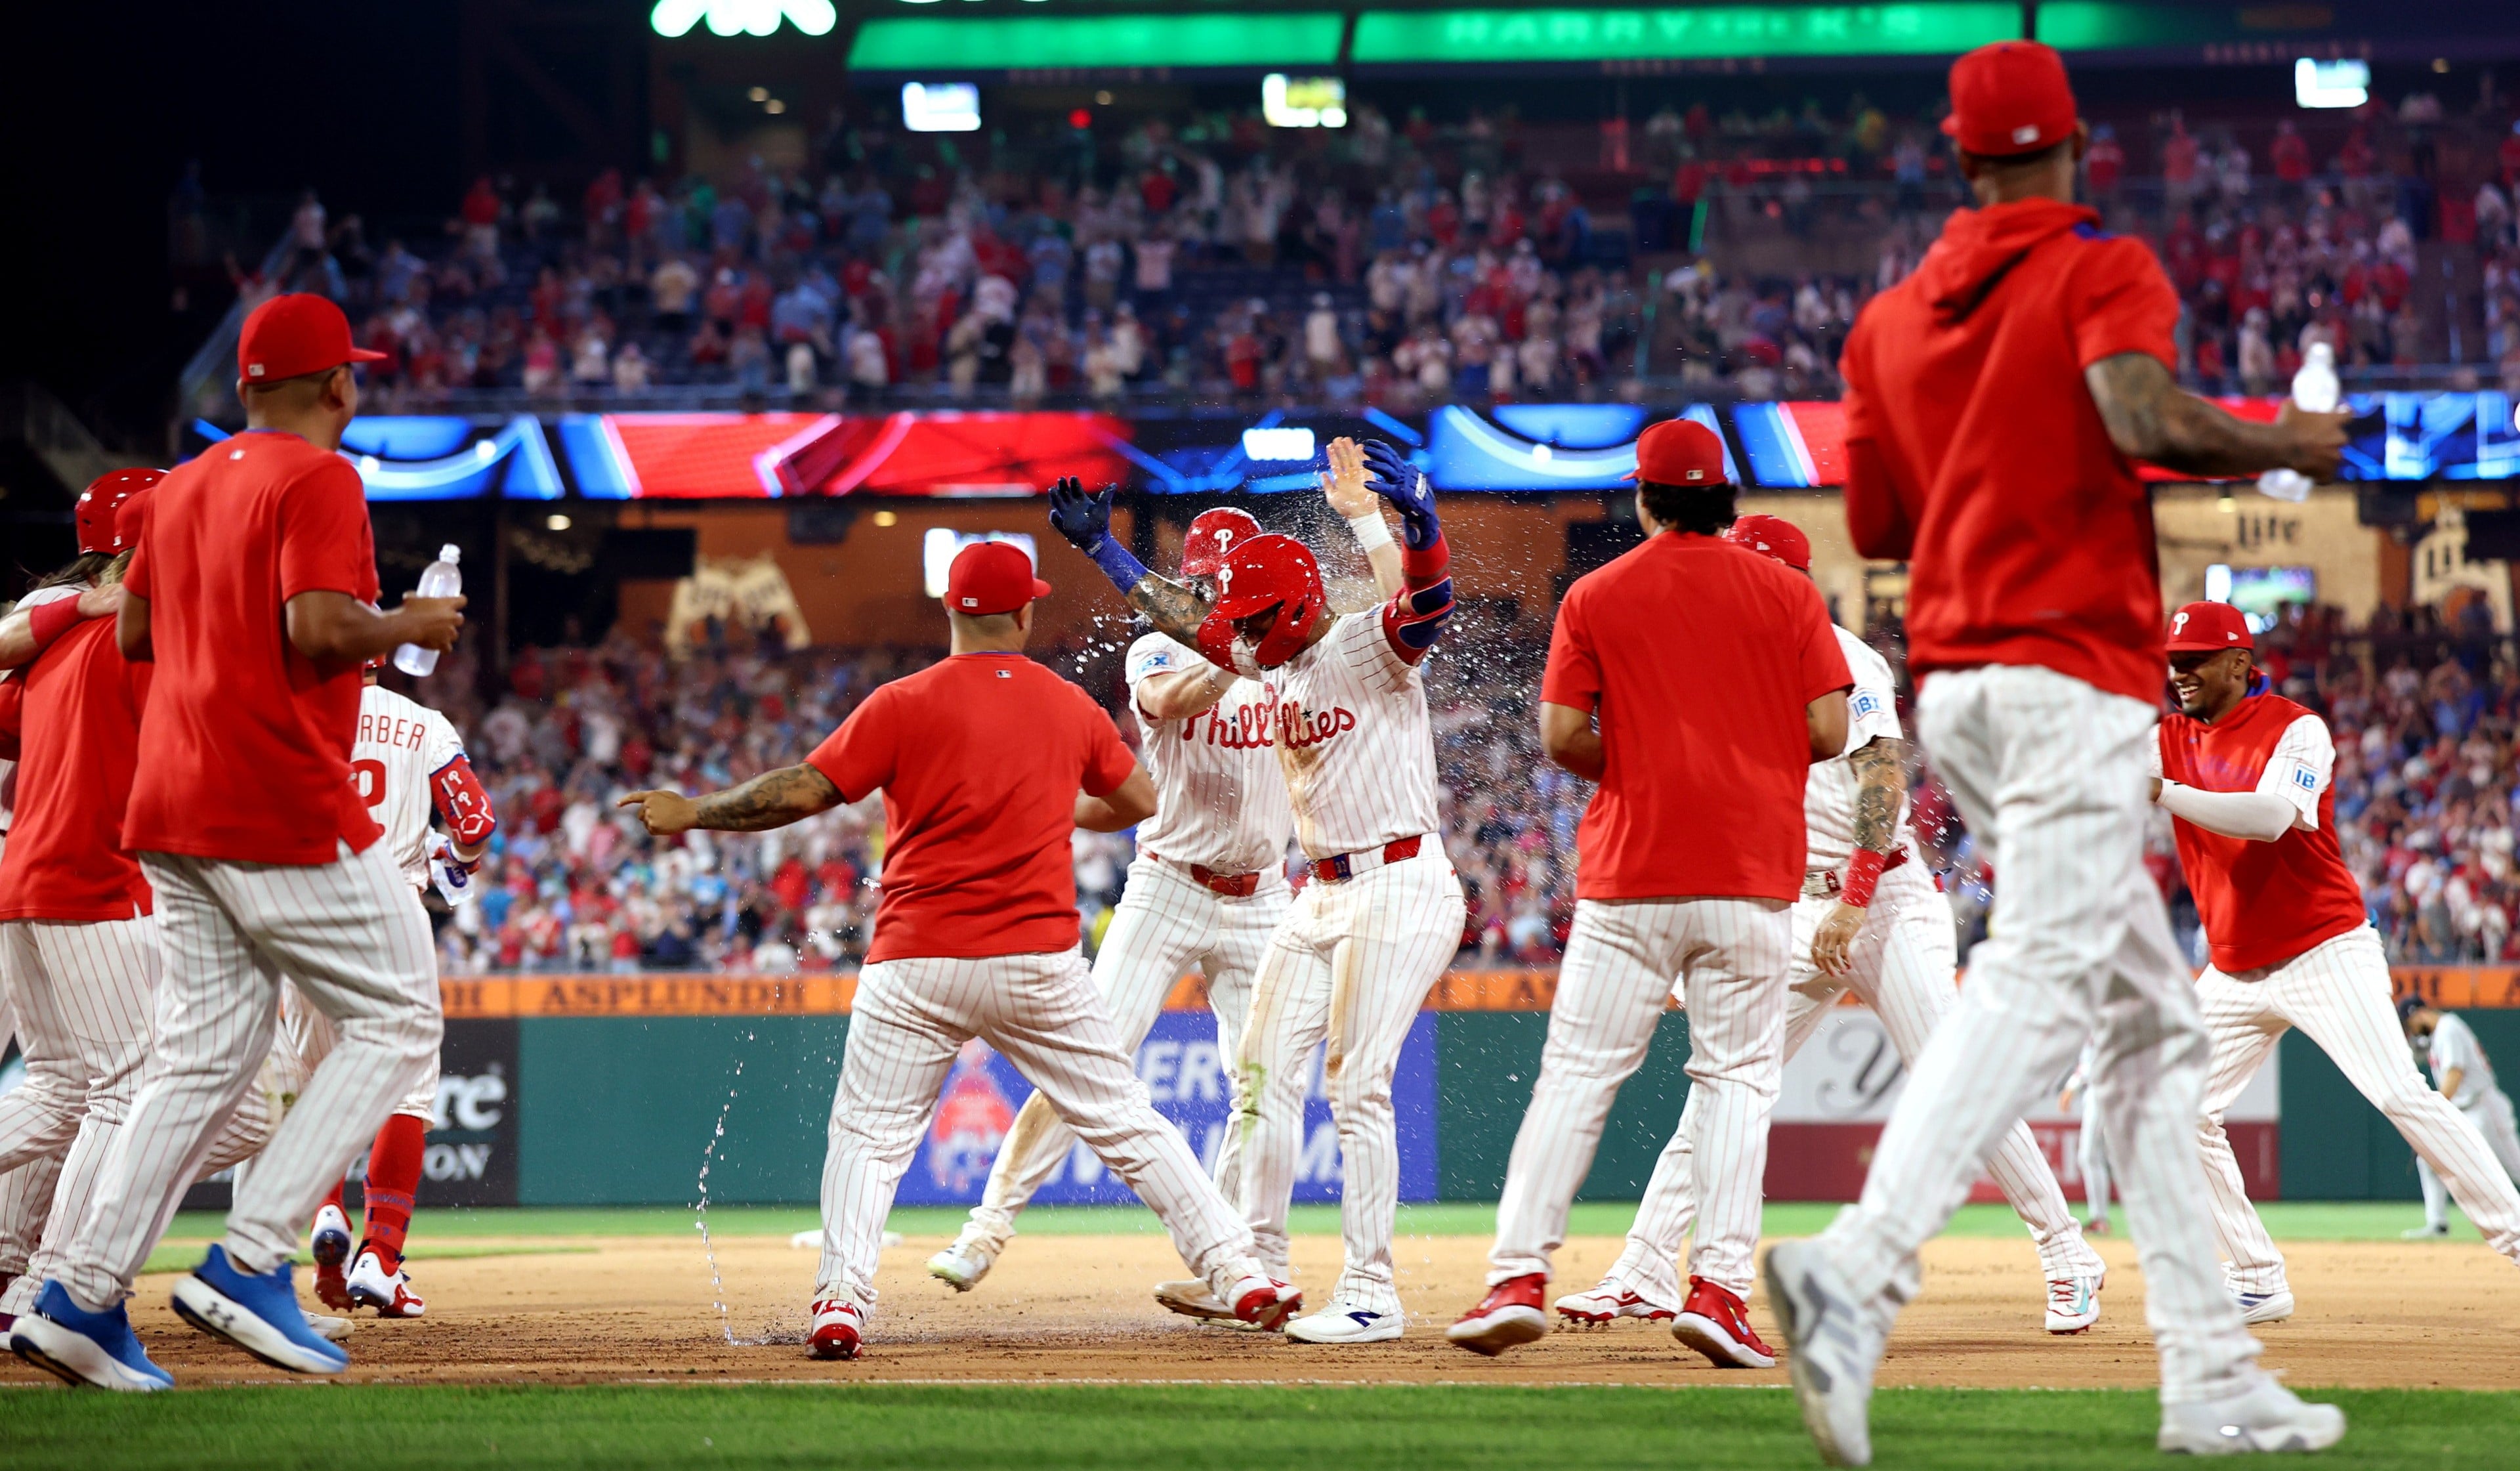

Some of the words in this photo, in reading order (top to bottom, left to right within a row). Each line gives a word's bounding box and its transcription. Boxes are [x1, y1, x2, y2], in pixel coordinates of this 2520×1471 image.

[1214, 528, 1234, 553] P
[1218, 568, 1234, 595] P
[2173, 612, 2190, 636] P
[541, 981, 807, 1008] ASPLUNDH
[829, 1300, 849, 1310] NIKE
